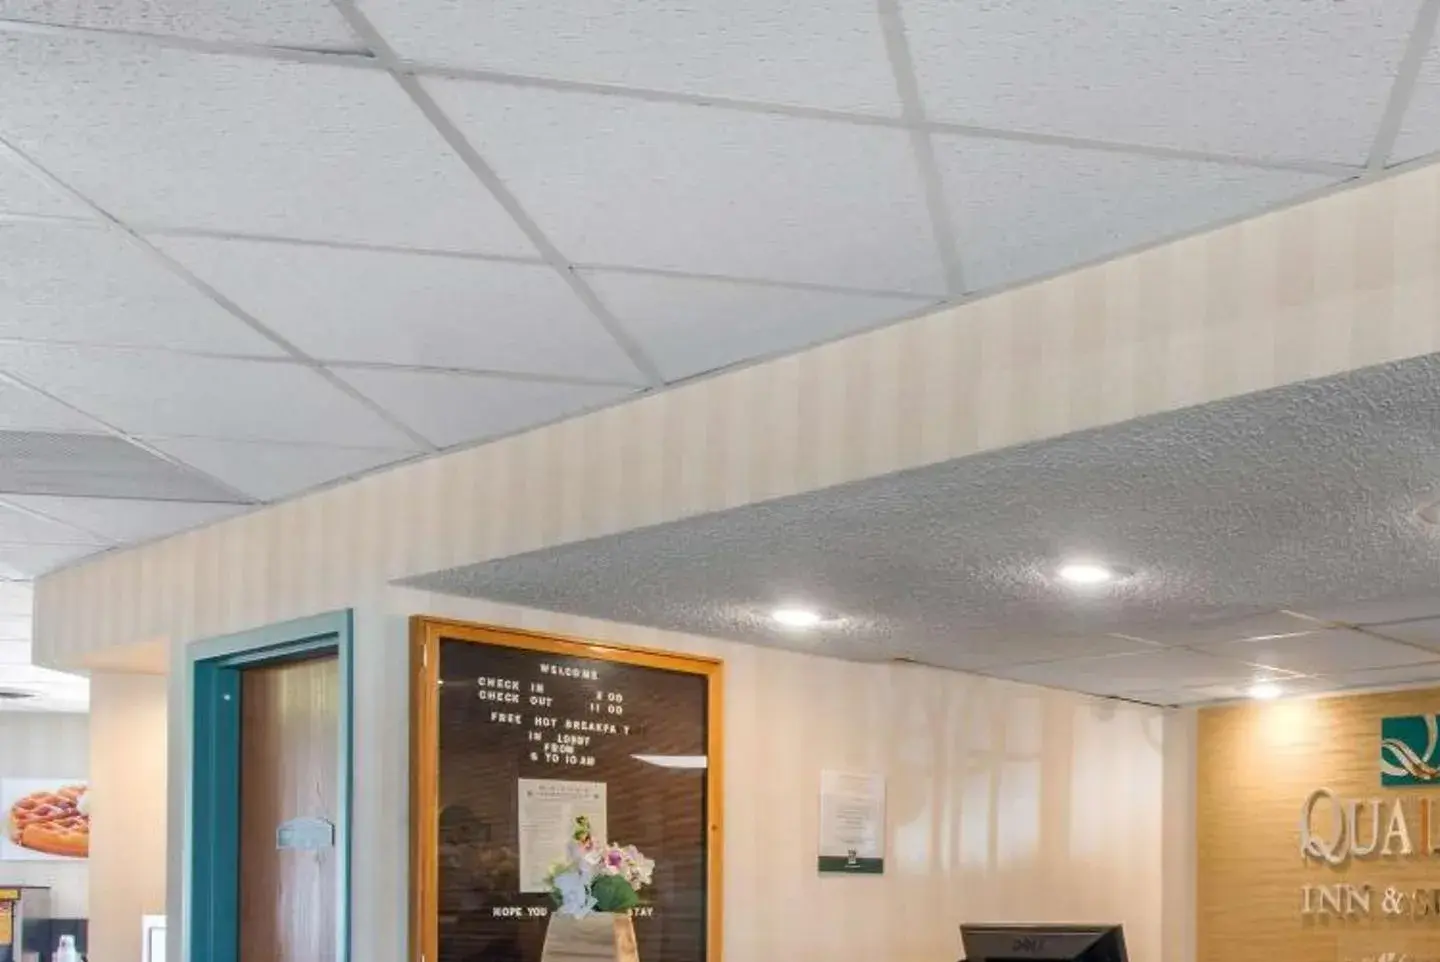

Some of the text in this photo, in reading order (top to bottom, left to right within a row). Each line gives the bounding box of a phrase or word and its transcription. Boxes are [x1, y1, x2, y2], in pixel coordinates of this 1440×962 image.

[540, 663, 599, 681] WELCOME
[477, 676, 520, 691] CHECK
[530, 682, 544, 694] IN
[478, 690, 520, 704] CHECK
[529, 695, 553, 708] OUT
[590, 702, 600, 714] 11
[490, 711, 630, 735] FREE HOT BREAKFAT
[528, 731, 590, 747] IN LOBBY
[544, 742, 575, 754] FROM
[545, 752, 559, 764] TO
[1301, 884, 1372, 916] INN
[1381, 886, 1403, 916] &
[492, 906, 522, 917] HOPE
[527, 906, 548, 917] YOU
